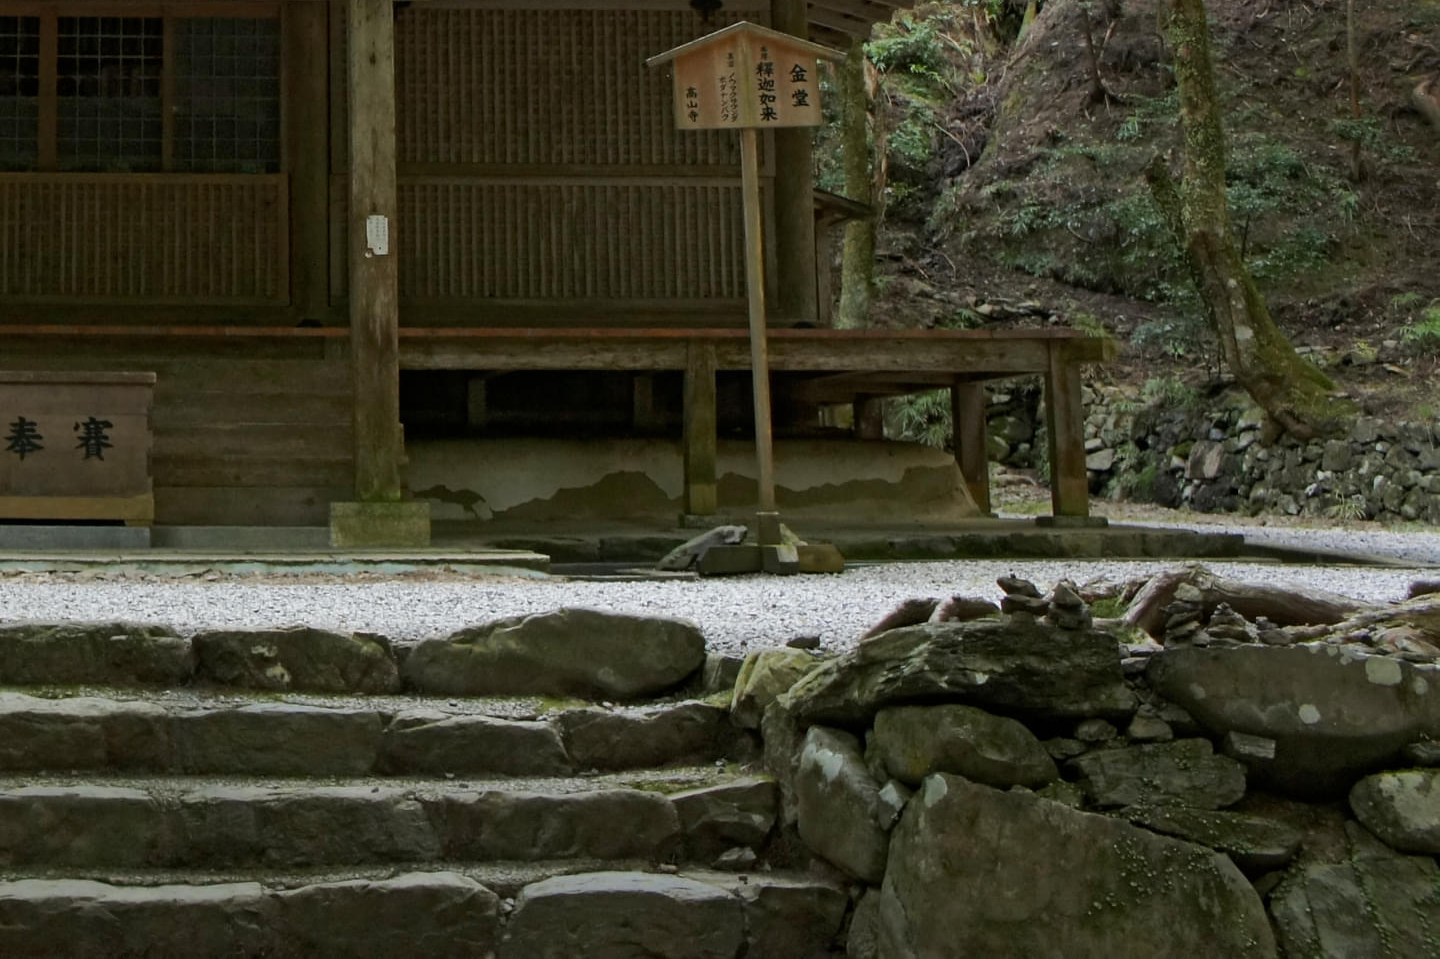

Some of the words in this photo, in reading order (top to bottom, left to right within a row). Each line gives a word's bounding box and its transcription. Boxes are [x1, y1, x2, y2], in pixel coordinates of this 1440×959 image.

[686, 86, 699, 123] 高山寺
[789, 64, 810, 107] 金堂
